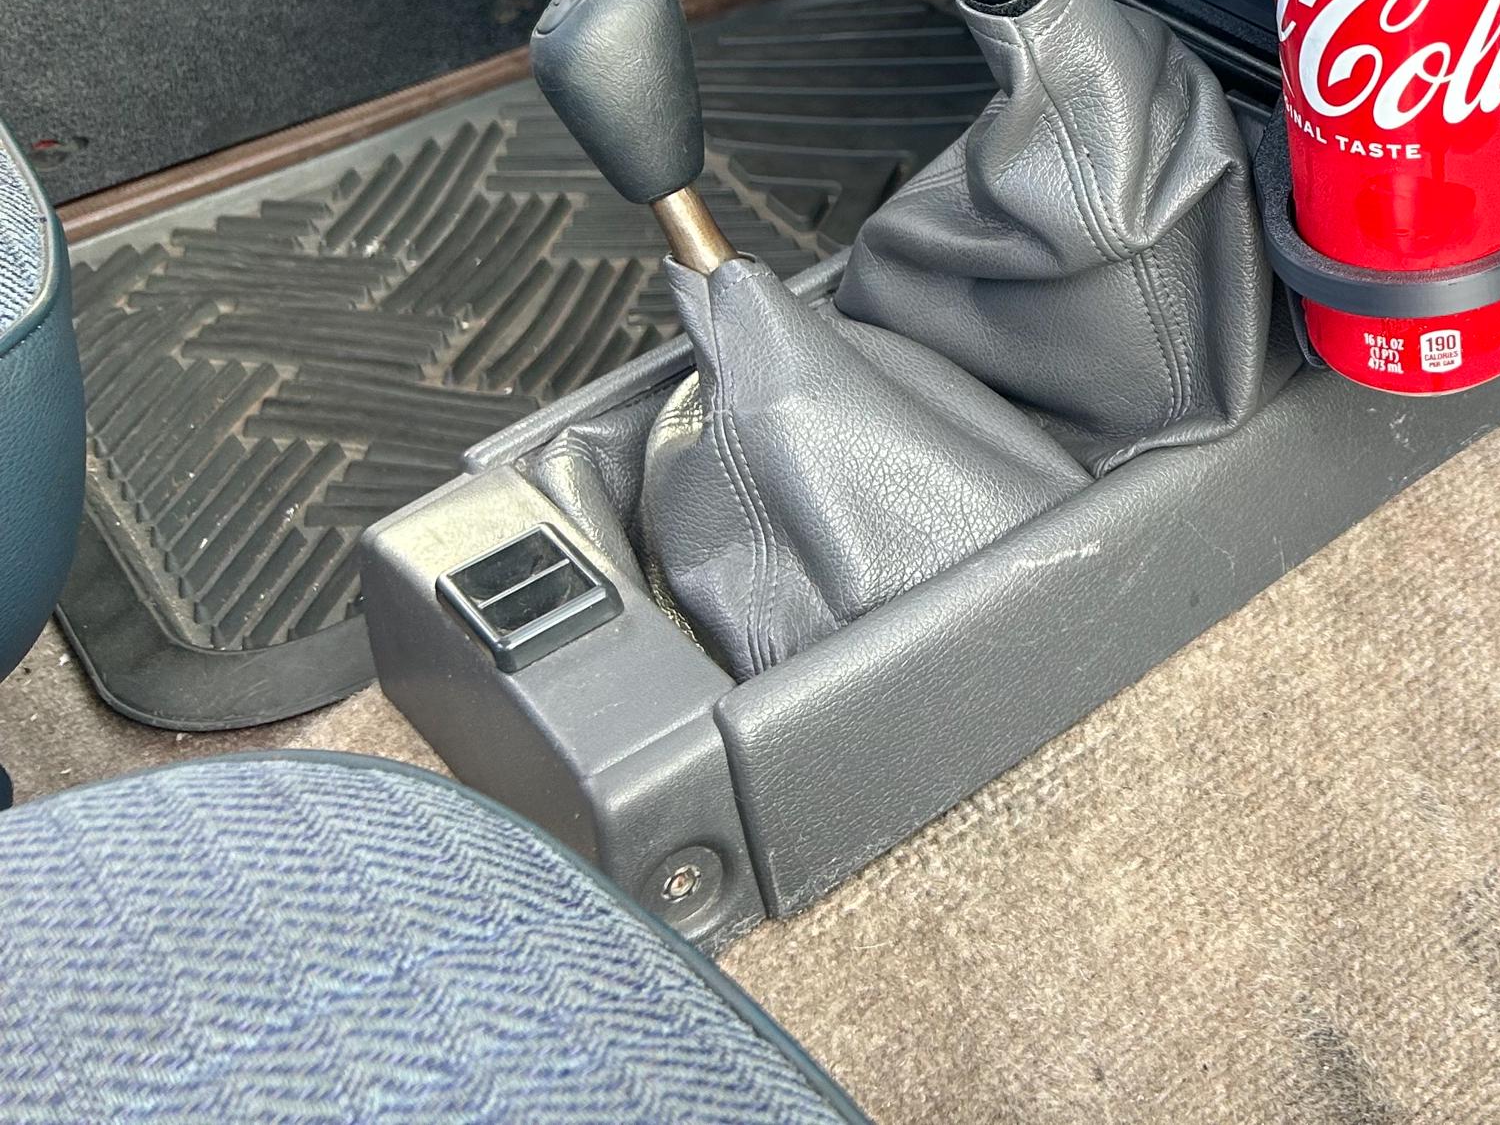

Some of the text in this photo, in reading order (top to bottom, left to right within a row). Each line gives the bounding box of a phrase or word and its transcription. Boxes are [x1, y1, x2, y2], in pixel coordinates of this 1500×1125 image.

[1335, 134, 1422, 160] TASTE
[1364, 333, 1404, 351] 16 FL OZ
[1425, 334, 1457, 352] 190
[1424, 350, 1459, 362] CALORIES
[1368, 358, 1404, 375] 473 mL
